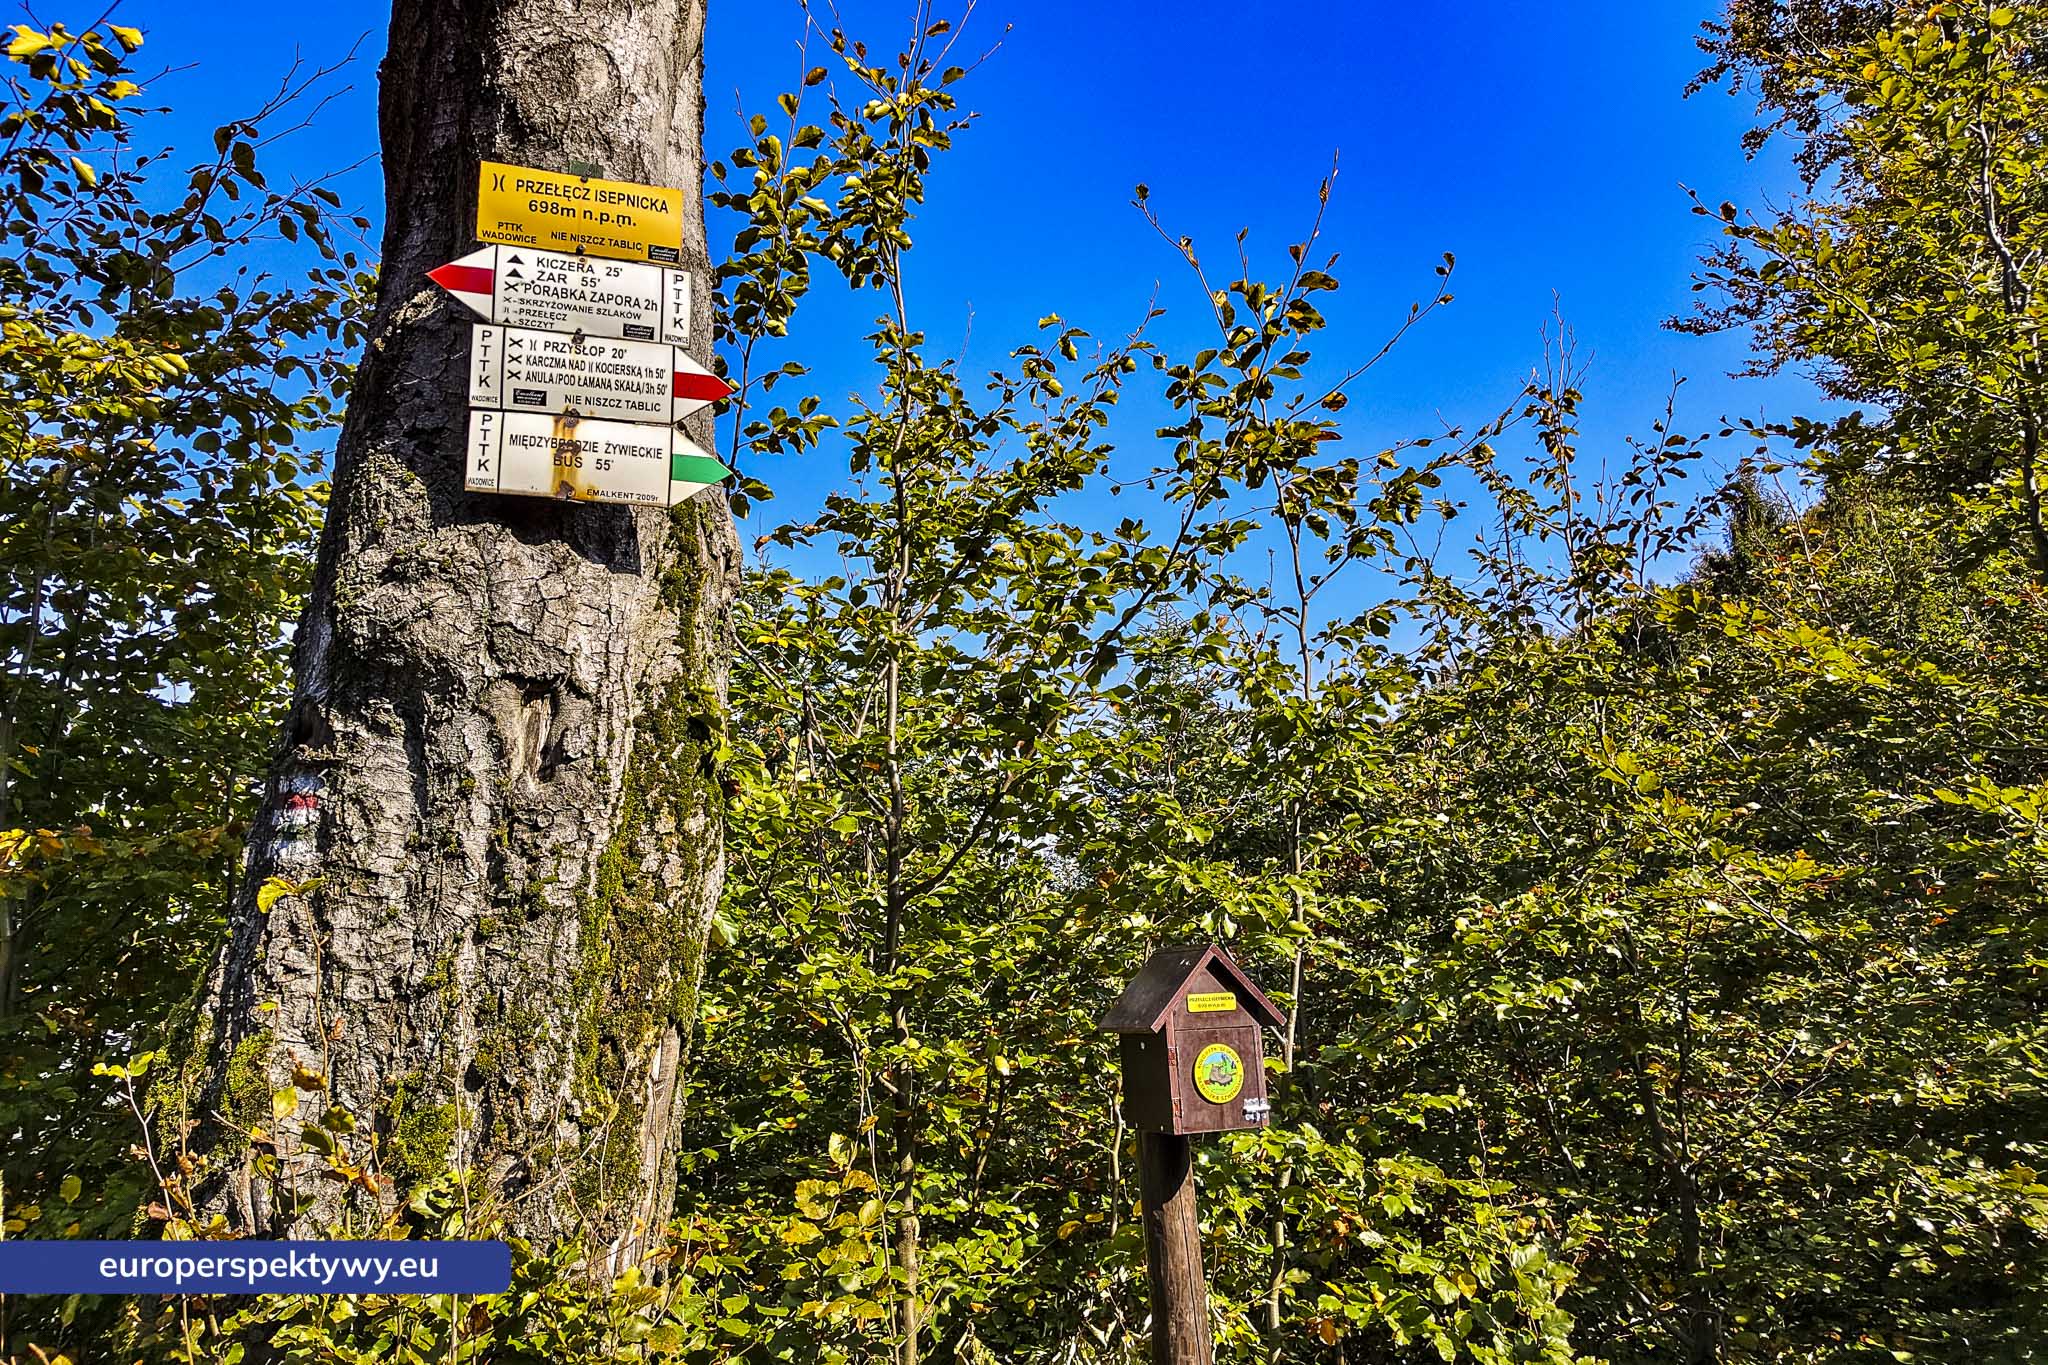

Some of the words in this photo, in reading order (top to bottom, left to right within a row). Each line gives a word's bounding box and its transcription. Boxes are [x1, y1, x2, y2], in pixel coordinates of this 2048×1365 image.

[516, 179, 591, 202] PRZEŁĘCZ
[595, 189, 669, 214] ISEPNICKA
[528, 199, 576, 218] 698m
[583, 208, 637, 227] n.p.m.
[497, 221, 523, 232] PTTK
[481, 230, 537, 245] WADOWICE
[551, 231, 567, 241] NIE
[570, 234, 605, 246] NISZCZ
[608, 238, 644, 251] TABLIC
[536, 256, 595, 274] KICZERA
[589, 291, 642, 309] ZAPORA
[644, 299, 658, 312] 2h
[518, 308, 568, 321] PRZEŁĘCZ
[518, 318, 555, 329] SZCZYT
[543, 340, 606, 357] PRZYSŁOP
[526, 355, 567, 370] KARCZMA
[568, 359, 586, 371] NAD
[596, 361, 643, 379] KOCIERSKĄ
[644, 367, 654, 379] 1h
[564, 394, 582, 405] NIE
[584, 396, 622, 409] NISZCZ
[625, 400, 661, 412] TABLIC
[604, 441, 663, 460] ŻYWIECKIE
[553, 454, 583, 469] BUS
[586, 488, 634, 500] EMALKENT
